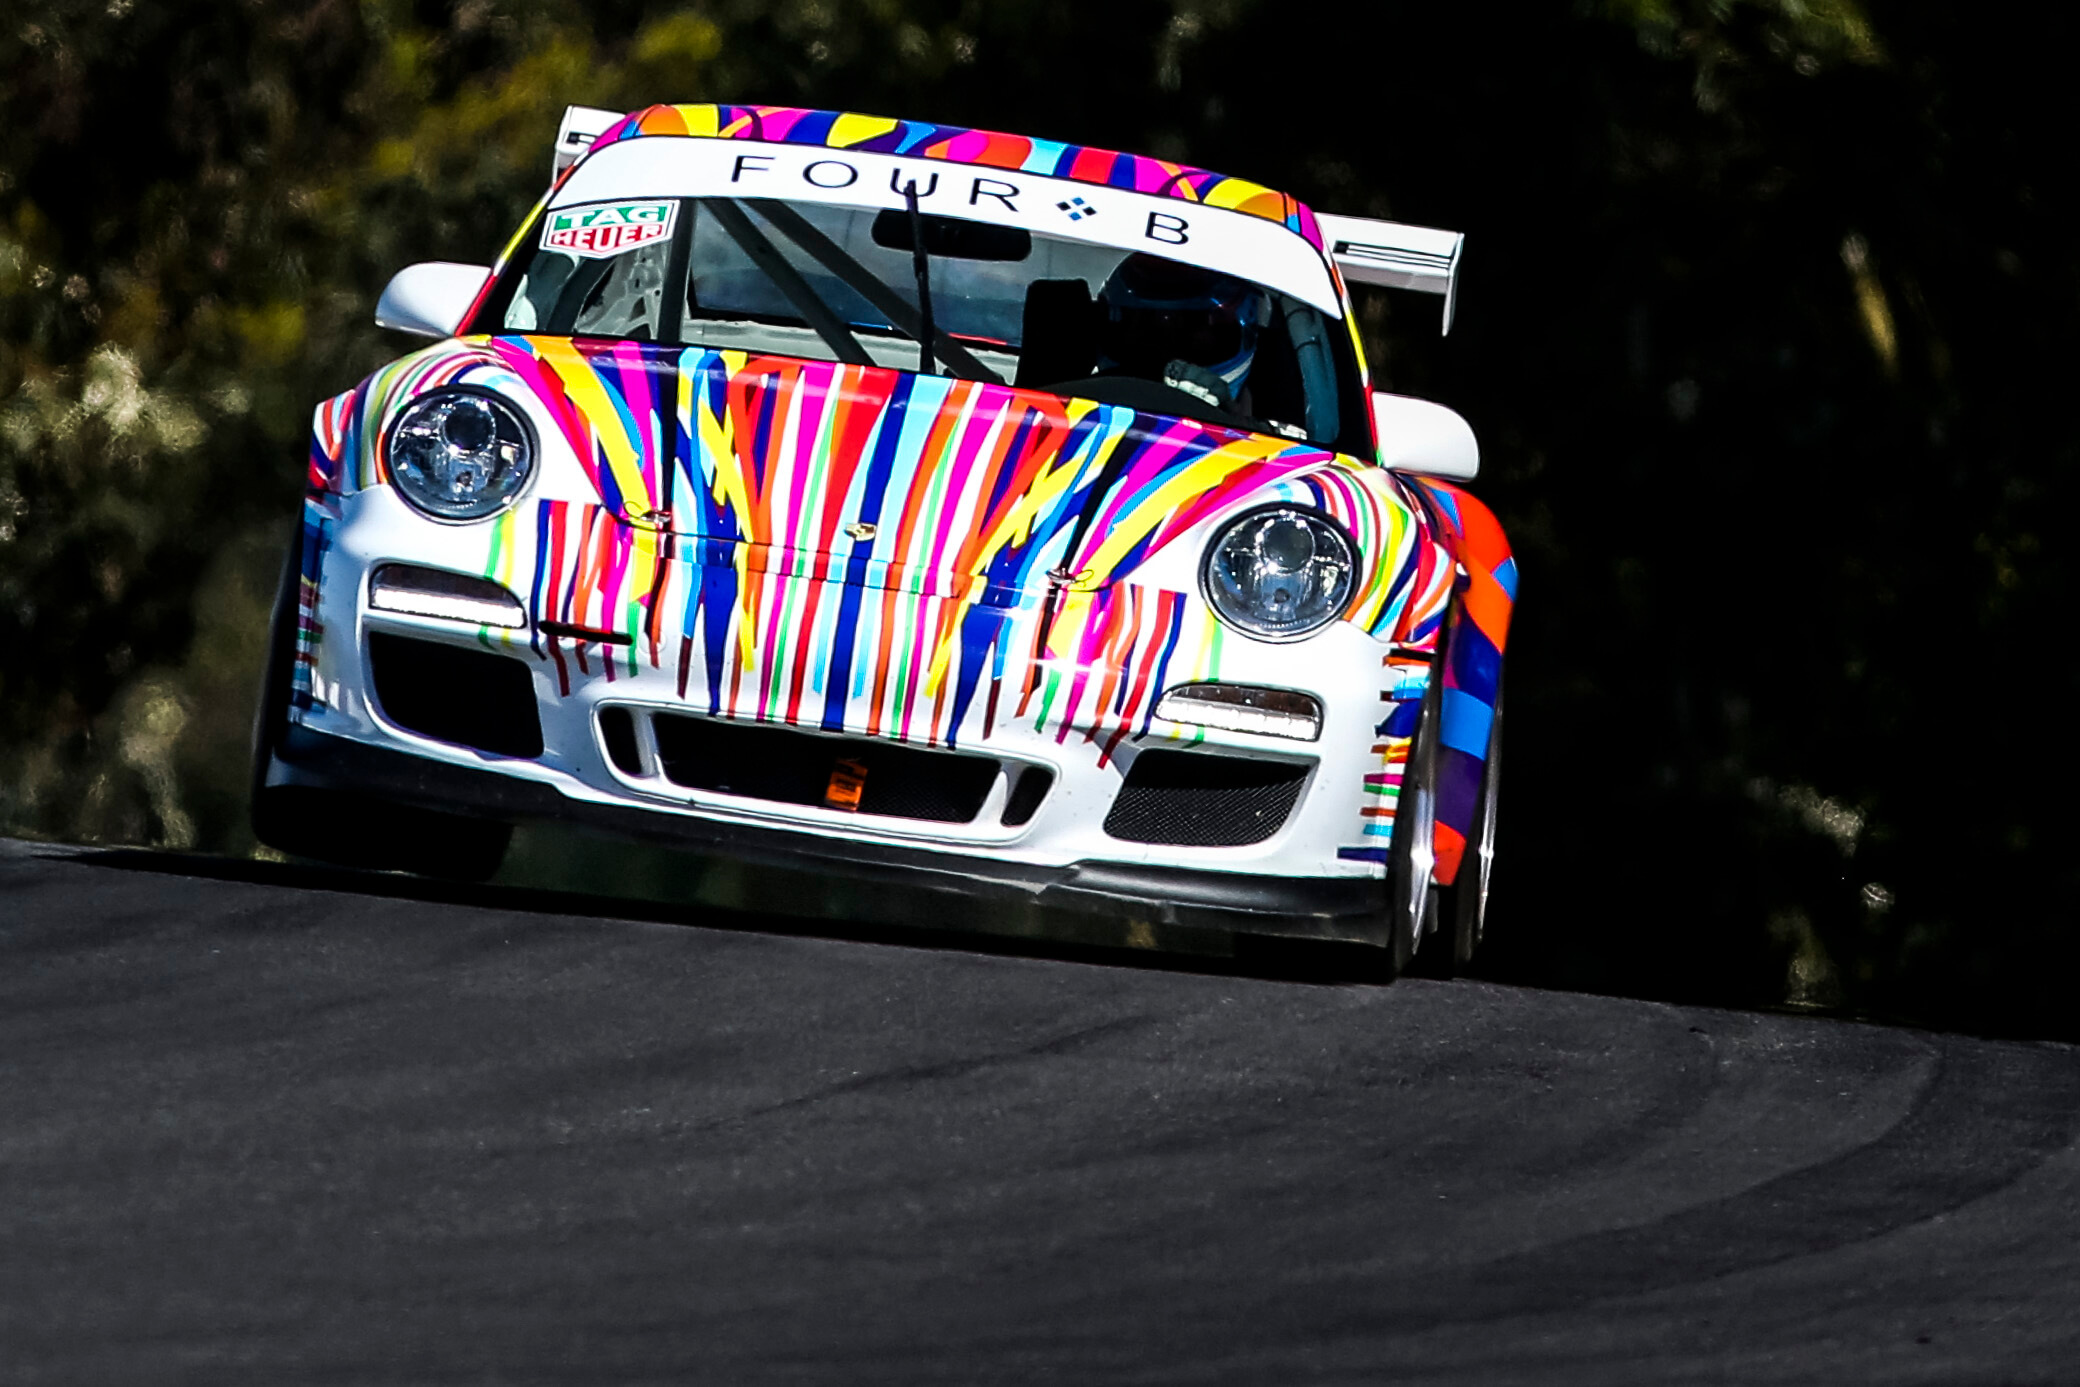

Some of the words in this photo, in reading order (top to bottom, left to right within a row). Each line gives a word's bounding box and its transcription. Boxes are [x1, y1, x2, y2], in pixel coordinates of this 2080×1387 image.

[731, 155, 1021, 213] FOUR
[1144, 211, 1190, 246] B
[560, 206, 660, 228] TAG
[552, 225, 661, 250] HEUER
